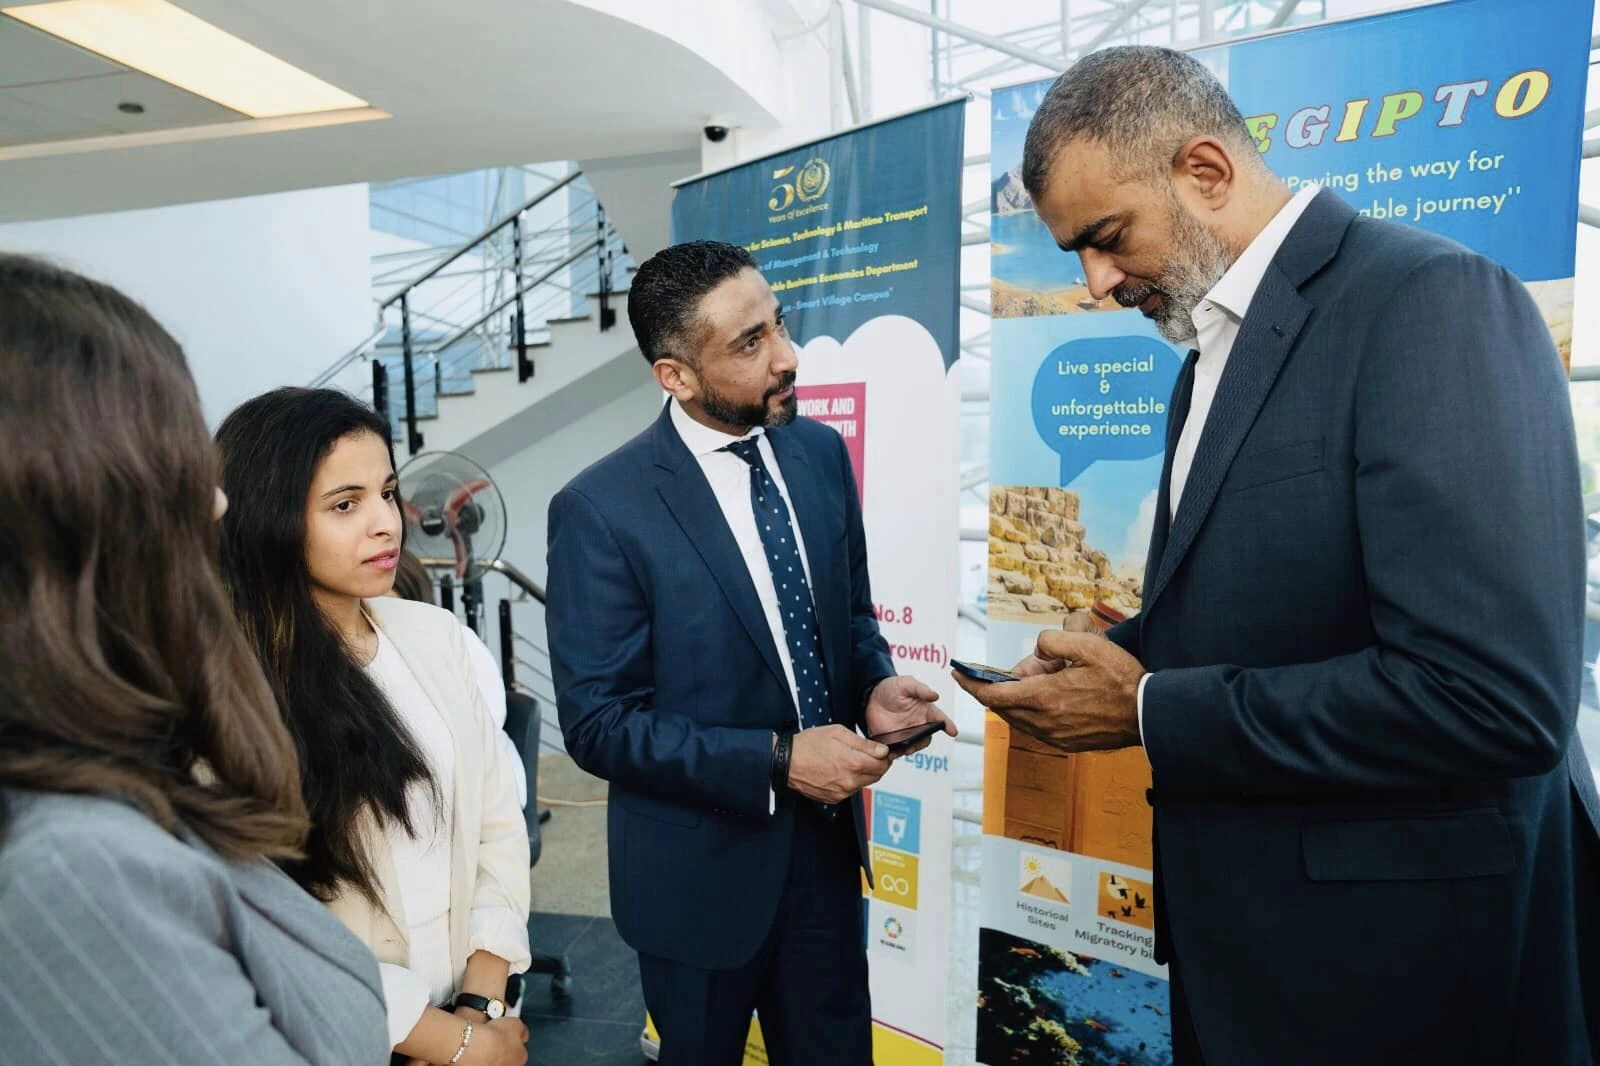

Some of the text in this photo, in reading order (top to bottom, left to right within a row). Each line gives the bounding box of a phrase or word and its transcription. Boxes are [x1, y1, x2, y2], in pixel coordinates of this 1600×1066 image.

[1244, 69, 1551, 153] EGIPTO
[1366, 162, 1401, 184] the
[1410, 156, 1460, 181] way
[1468, 150, 1505, 172] for
[1359, 197, 1408, 220] able
[792, 225, 836, 241] Technology
[844, 216, 883, 230] Maritime
[884, 205, 928, 223] Transport
[831, 242, 879, 257] Technology
[819, 269, 864, 283] Economics
[866, 259, 918, 277] Department
[822, 295, 851, 307] Village
[1058, 354, 1154, 378] Live special
[1099, 379, 1111, 394] &
[797, 397, 856, 416] WORK AND
[1052, 397, 1165, 420] unforgettable
[1058, 421, 1152, 441] experience
[889, 643, 947, 668] rowth)
[1016, 901, 1069, 923] Historical
[1027, 915, 1056, 931] Sites
[1074, 928, 1153, 959] Migratory bi
[1096, 922, 1153, 948] Tracking
